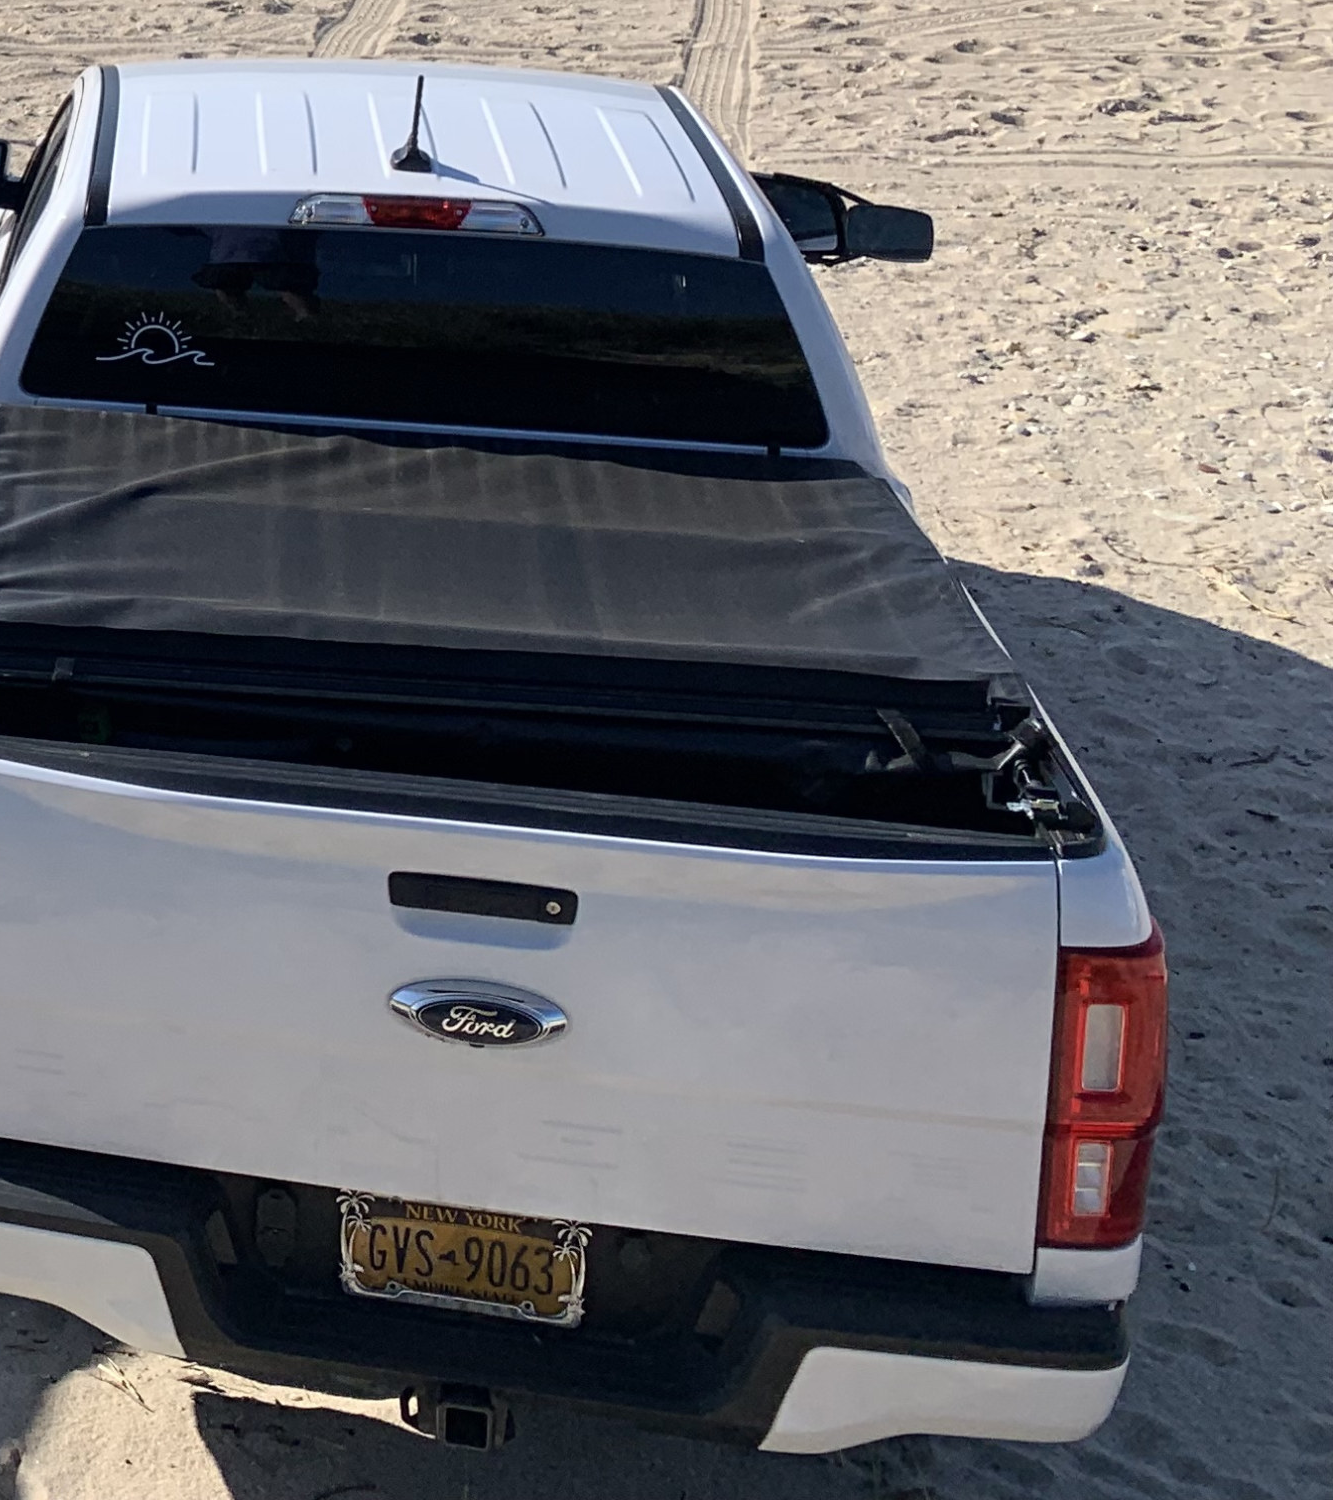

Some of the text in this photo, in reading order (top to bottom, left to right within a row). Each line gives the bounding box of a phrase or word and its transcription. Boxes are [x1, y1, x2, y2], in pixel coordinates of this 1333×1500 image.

[441, 1005, 517, 1038] Ford
[405, 1203, 522, 1234] NEW YORK
